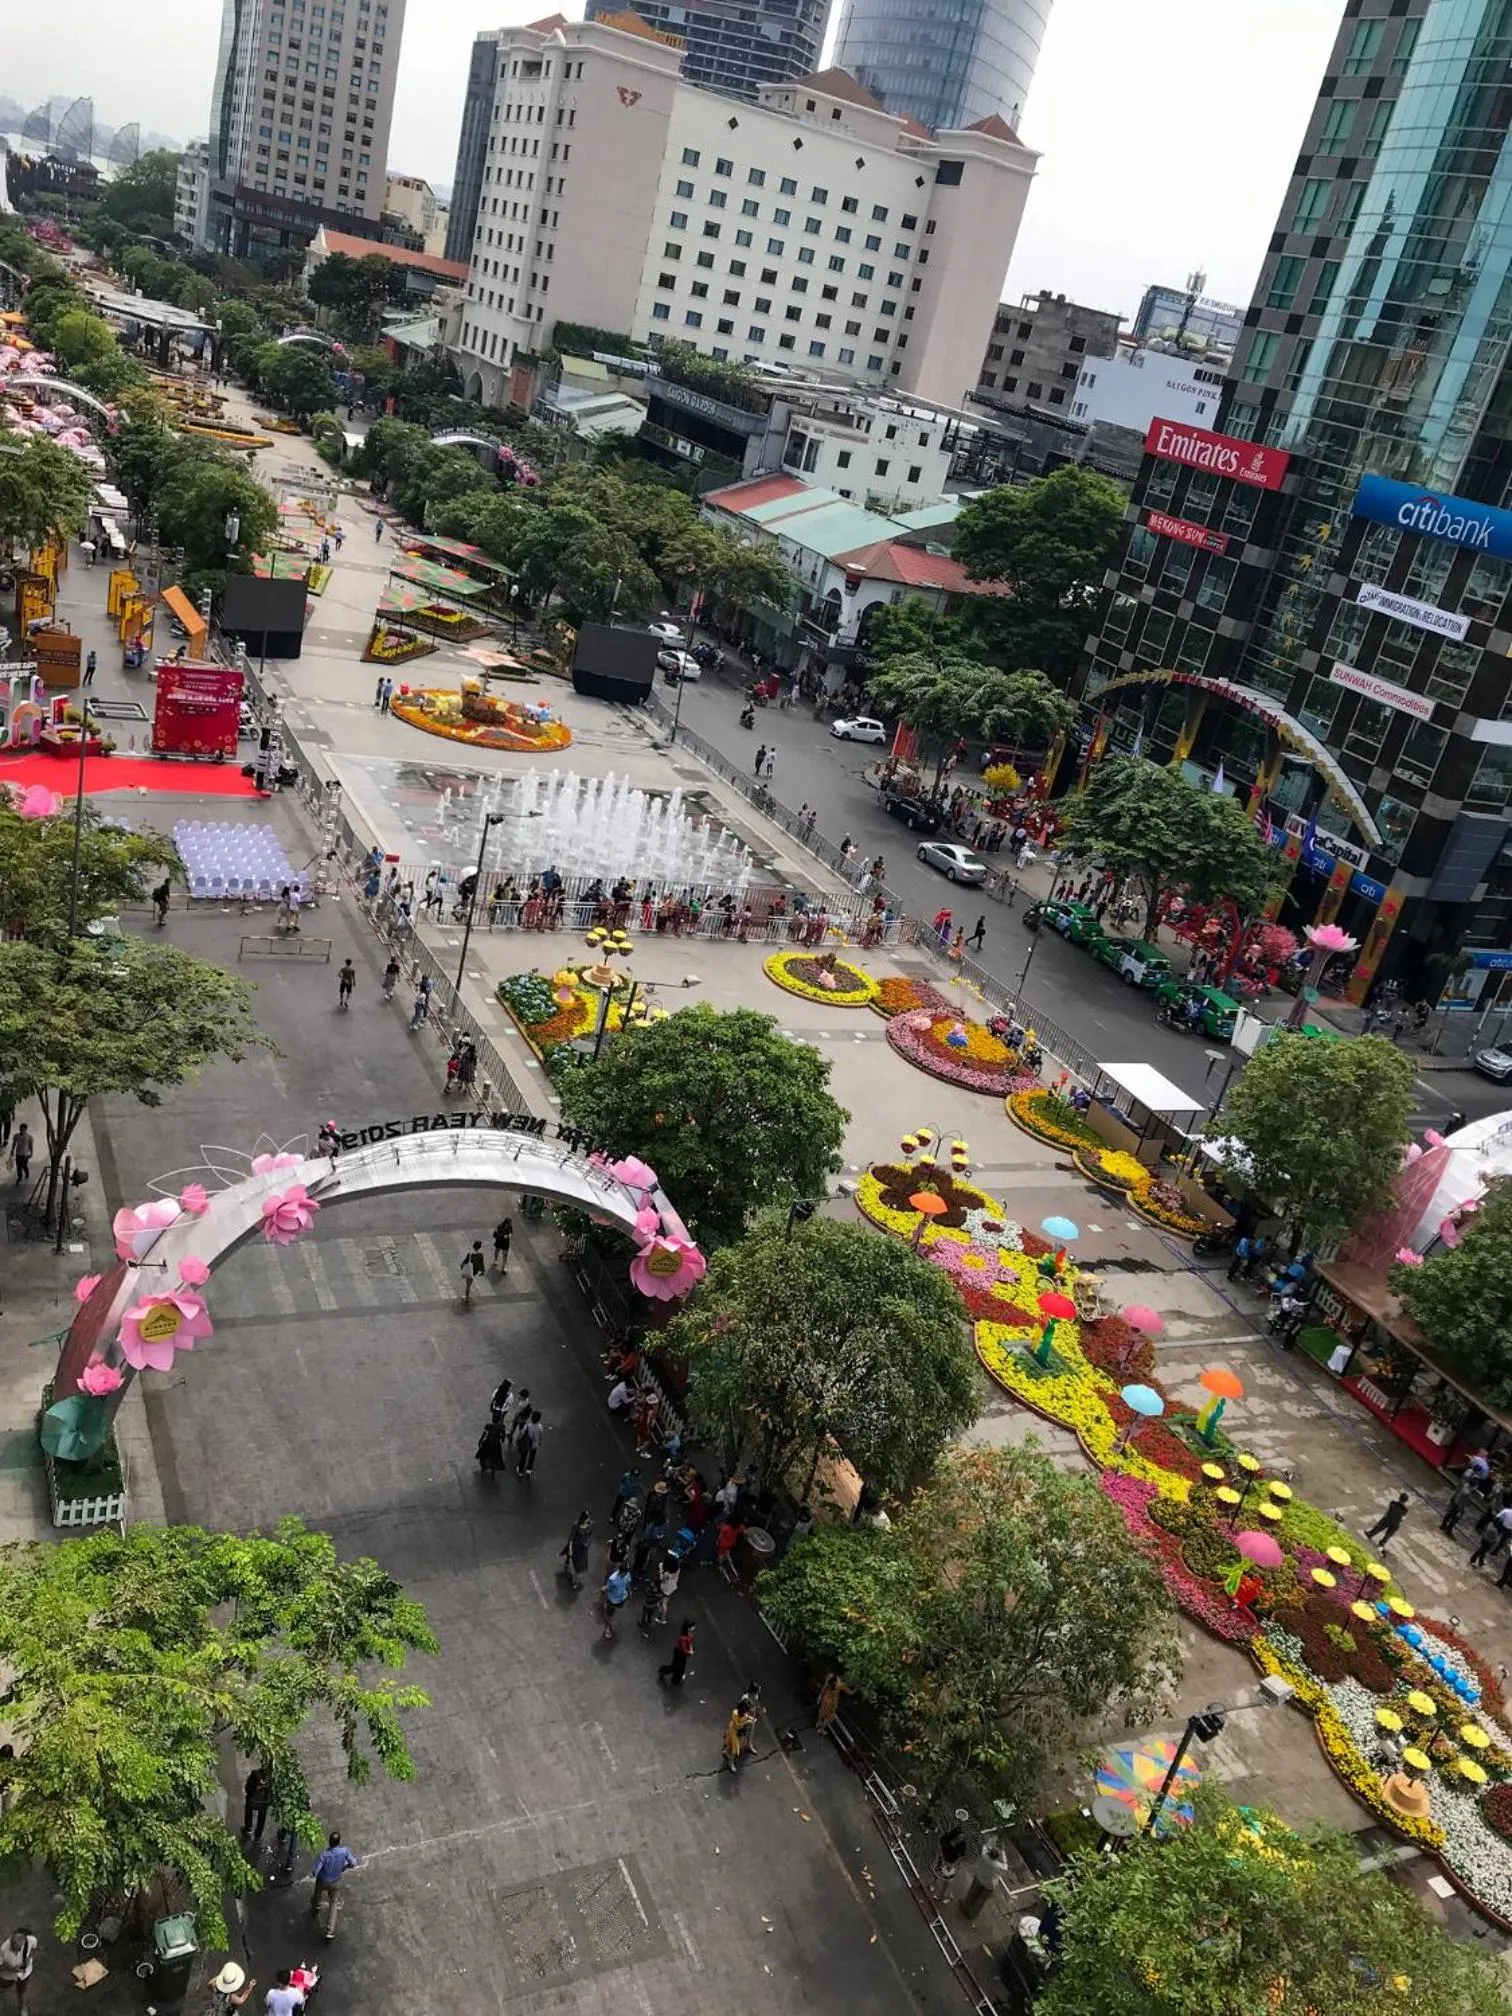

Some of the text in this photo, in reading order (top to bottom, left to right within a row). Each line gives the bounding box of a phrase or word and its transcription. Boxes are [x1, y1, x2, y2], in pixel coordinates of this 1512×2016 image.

[1157, 425, 1240, 473] Emirates
[1150, 514, 1184, 535] MEKONG
[1184, 526, 1205, 544] SUN
[1398, 496, 1496, 548] citibank
[1422, 608, 1464, 634] RELOCATION
[1333, 668, 1430, 716] SUNWAH Commodities
[1309, 832, 1363, 867] aCapital
